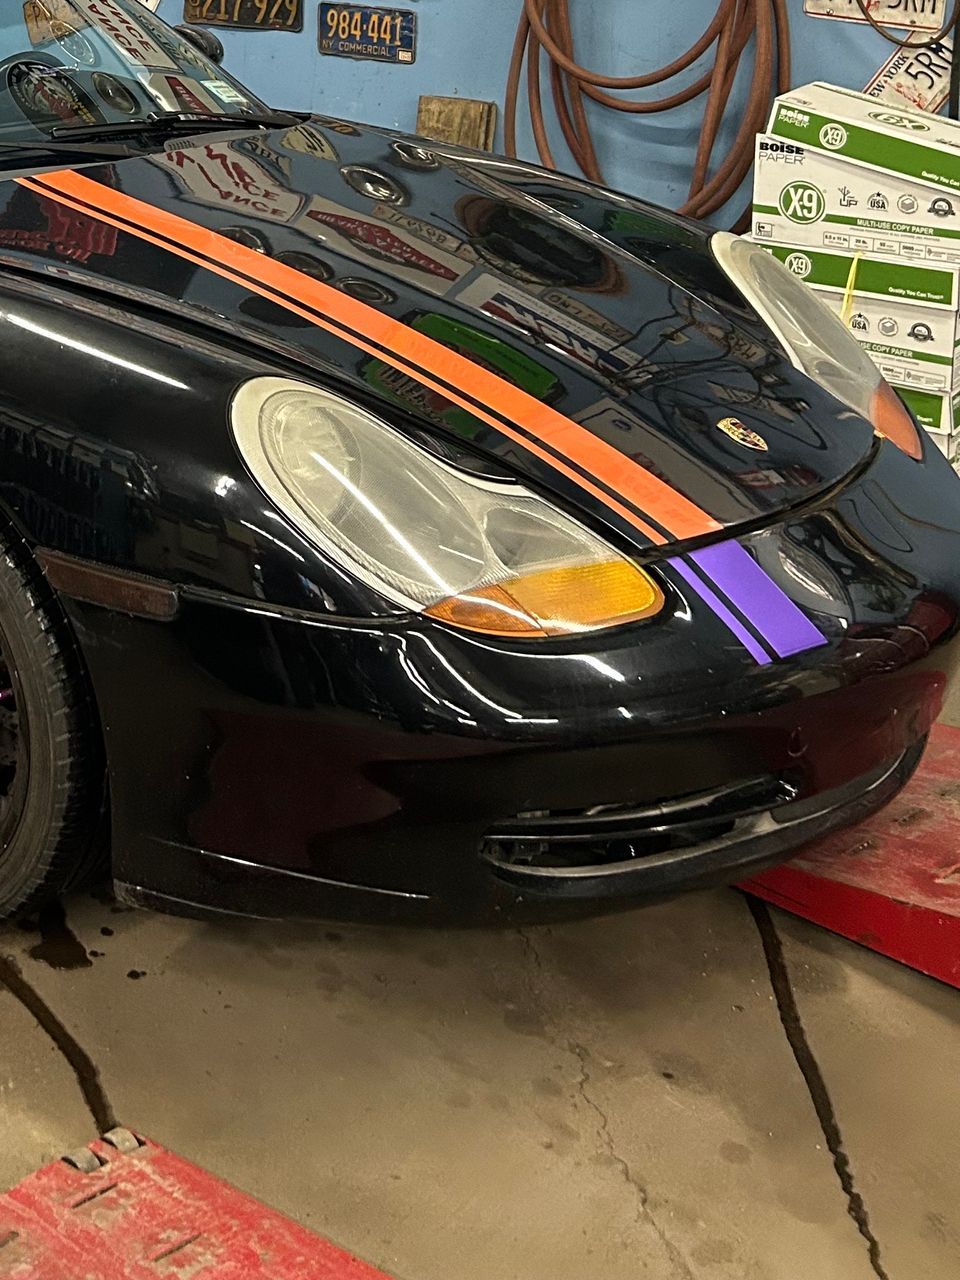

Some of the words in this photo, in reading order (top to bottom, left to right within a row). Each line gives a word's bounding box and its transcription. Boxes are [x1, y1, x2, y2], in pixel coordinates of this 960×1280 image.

[322, 39, 334, 48] NY
[338, 41, 391, 57] COMMERCIAL
[883, 53, 909, 81] YORK
[760, 141, 804, 155] BOISE
[759, 151, 804, 165] PAPER
[870, 200, 886, 210] USA
[857, 219, 890, 231] MULTI-USE
[892, 223, 910, 232] COPY
[912, 226, 934, 235] PAPER
[889, 286, 906, 296] Quality
[851, 321, 867, 331] USA
[872, 345, 890, 354] COPY
[891, 348, 913, 358] PAPER
